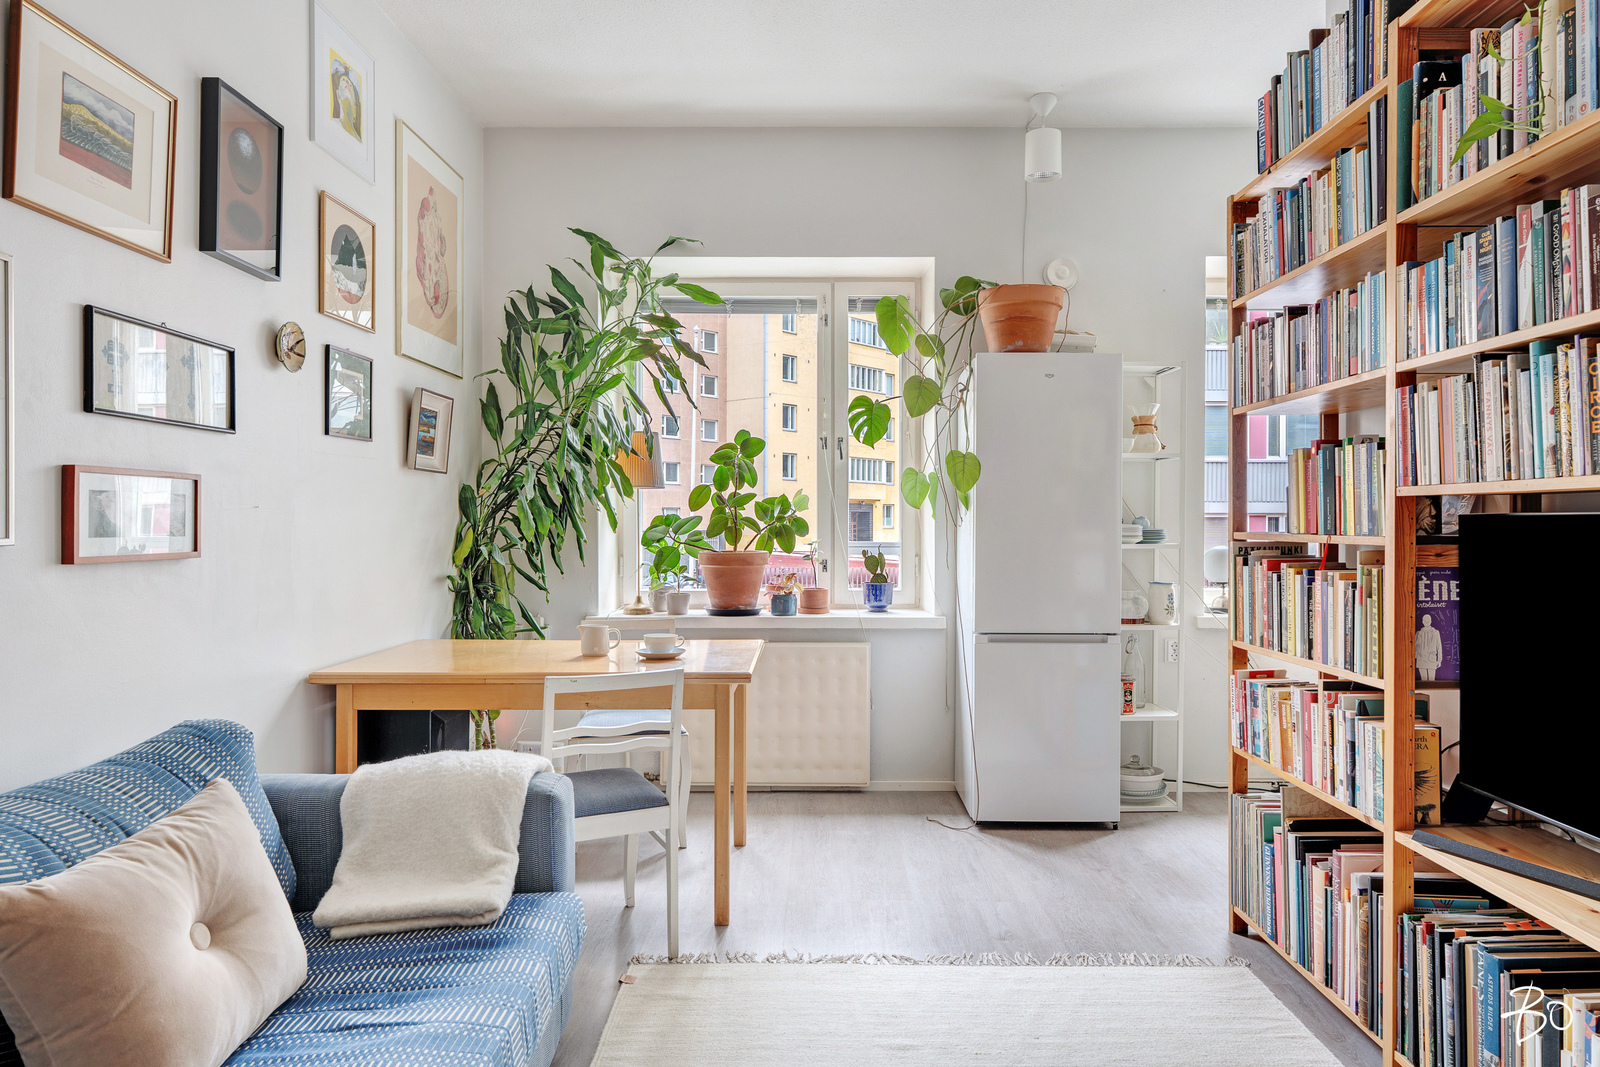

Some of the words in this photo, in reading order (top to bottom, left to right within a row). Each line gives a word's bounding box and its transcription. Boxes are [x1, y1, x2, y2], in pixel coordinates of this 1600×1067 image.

[1438, 72, 1447, 82] A
[1480, 244, 1492, 254] NIGHT
[1552, 250, 1560, 276] OMENS
[1589, 362, 1600, 434] CIRCE
[1314, 892, 1324, 931] ART
